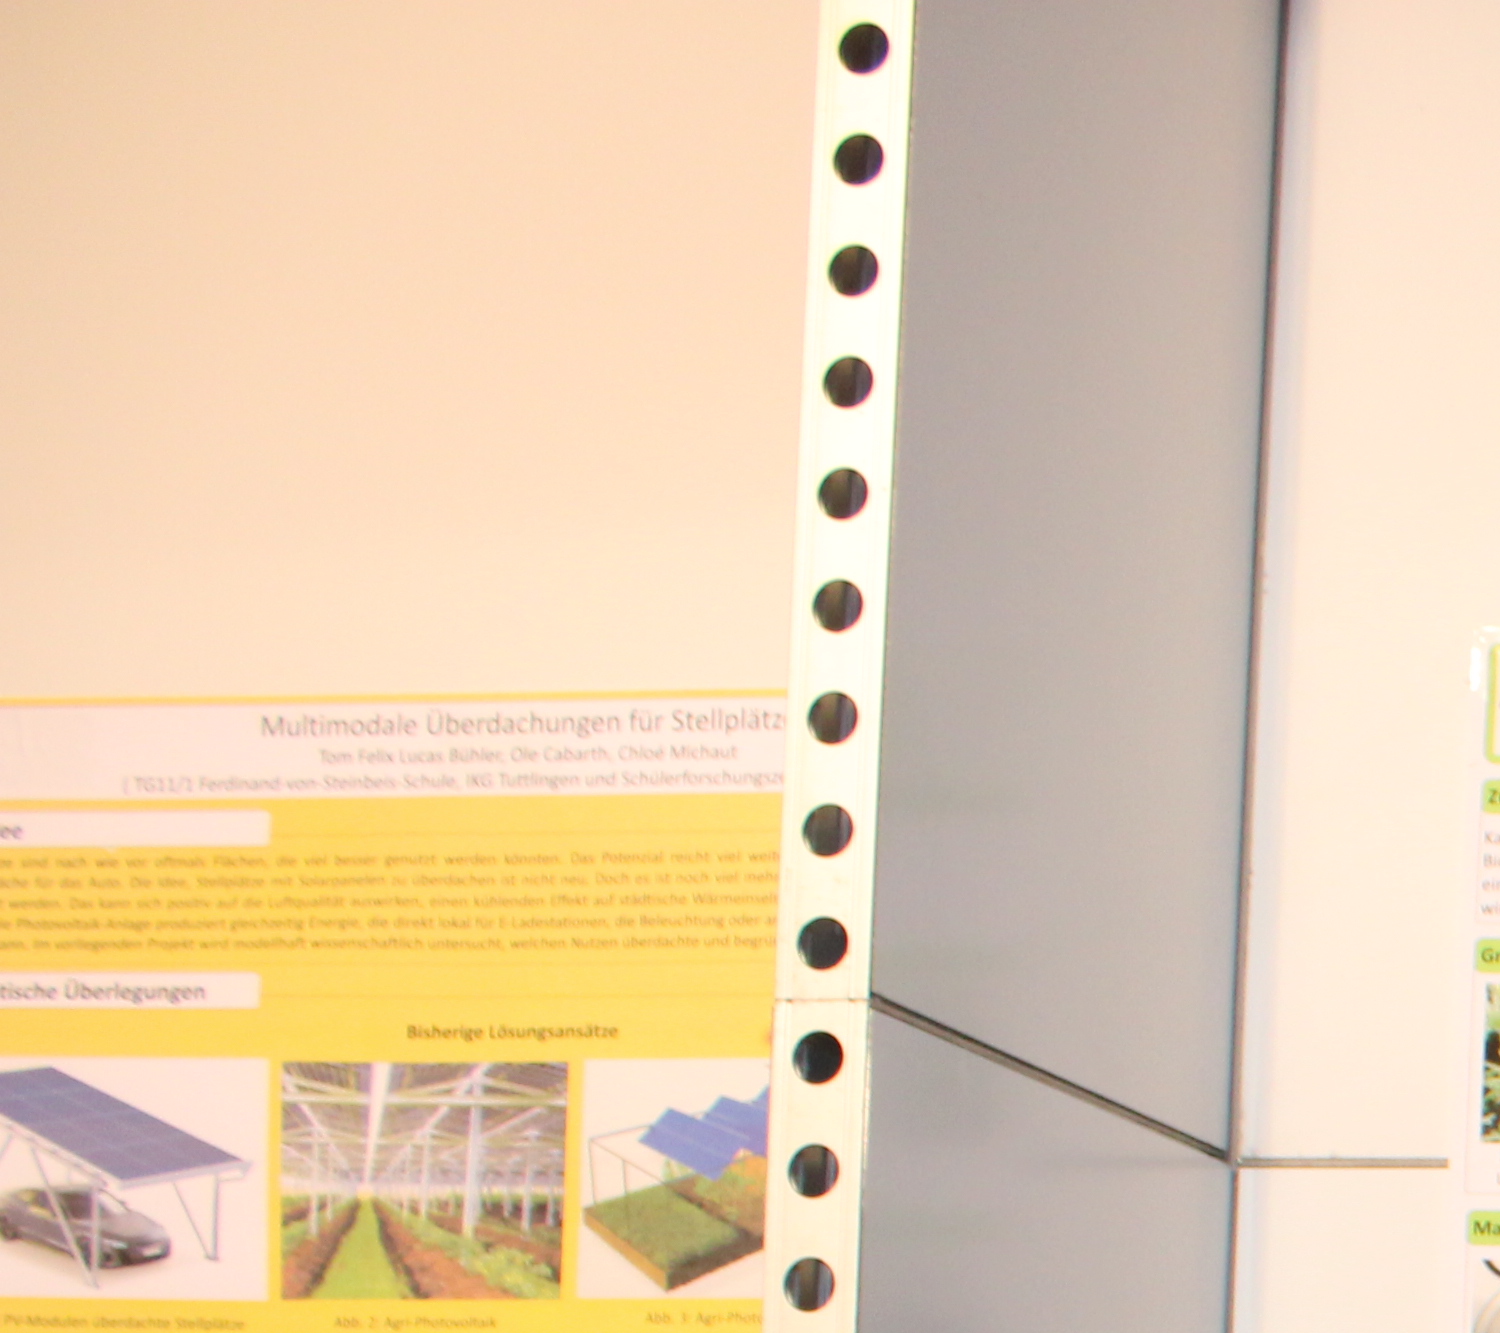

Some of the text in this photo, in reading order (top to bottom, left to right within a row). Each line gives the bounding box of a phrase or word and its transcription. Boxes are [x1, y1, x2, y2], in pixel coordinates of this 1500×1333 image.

[260, 714, 418, 737] Multimodale
[427, 710, 621, 738] Überdachungen
[629, 709, 664, 732] für
[407, 1024, 620, 1043] Bisherige Lösungsansätze
